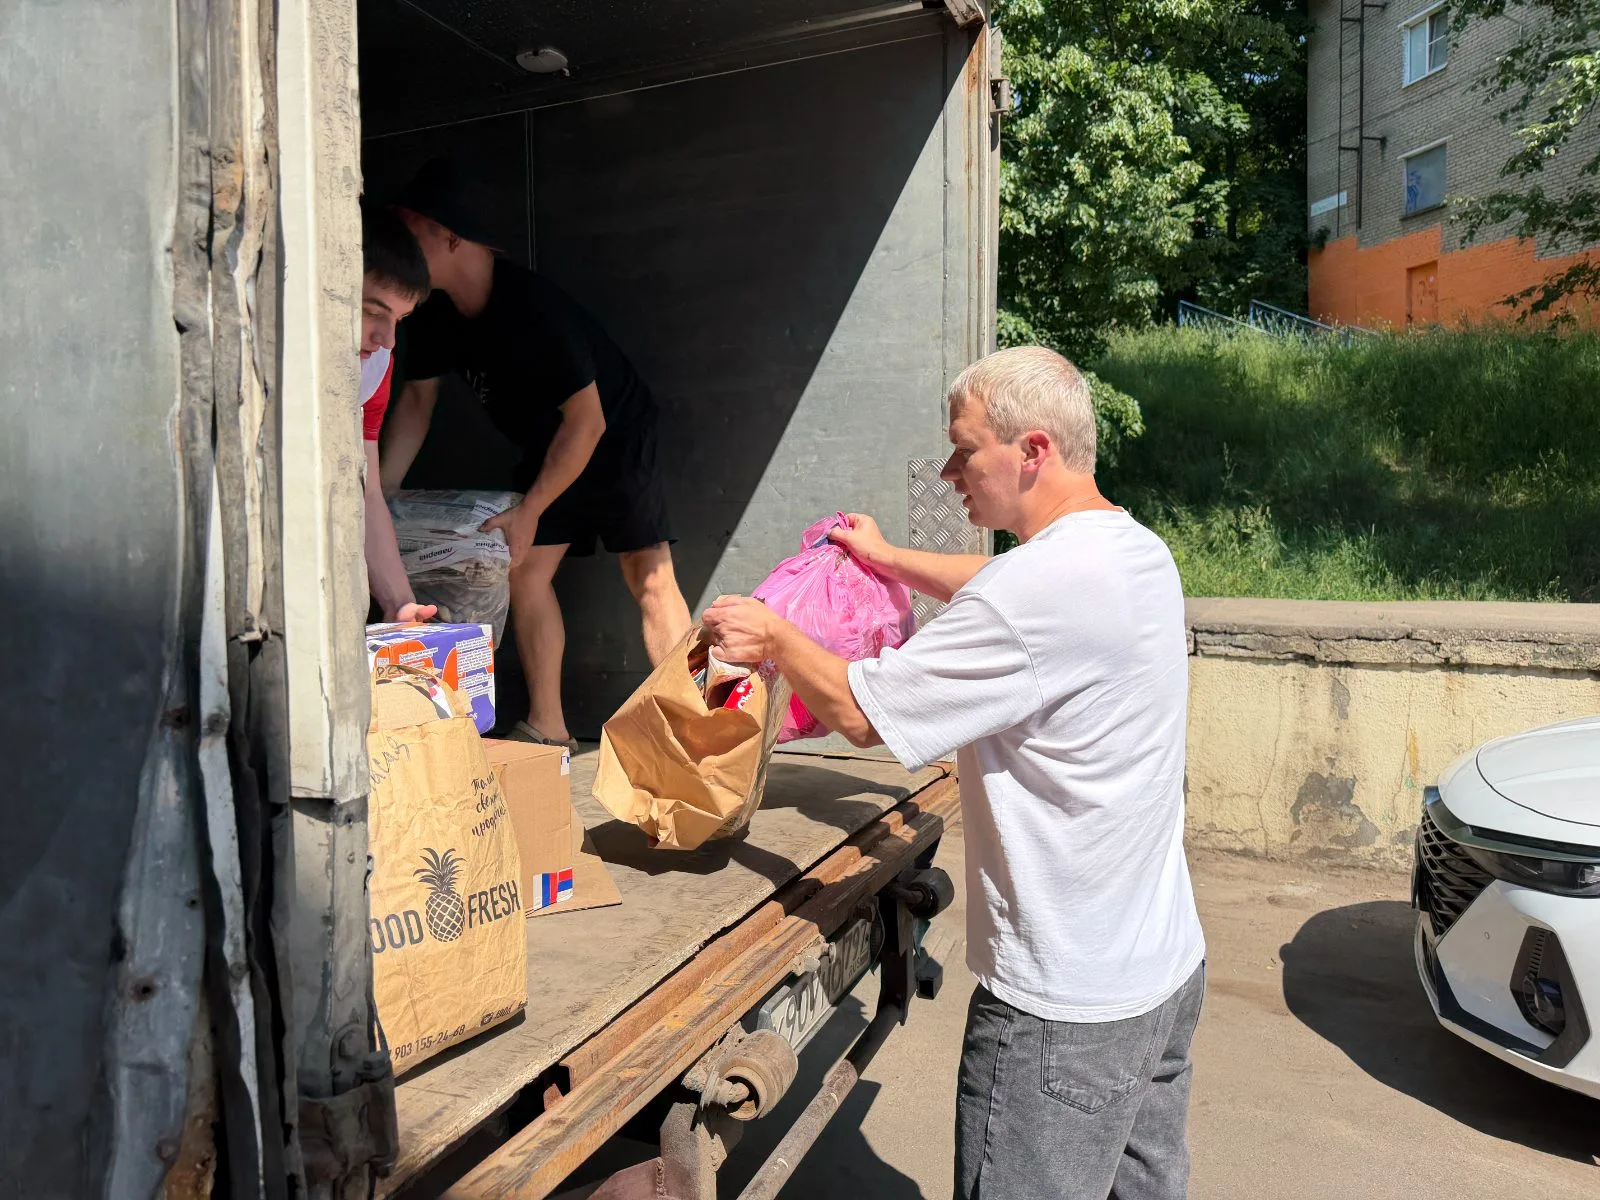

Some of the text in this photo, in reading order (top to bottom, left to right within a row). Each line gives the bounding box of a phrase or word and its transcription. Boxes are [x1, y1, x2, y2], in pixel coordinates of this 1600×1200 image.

[369, 879, 521, 954] OOD FRESH
[394, 1042, 413, 1061] 903
